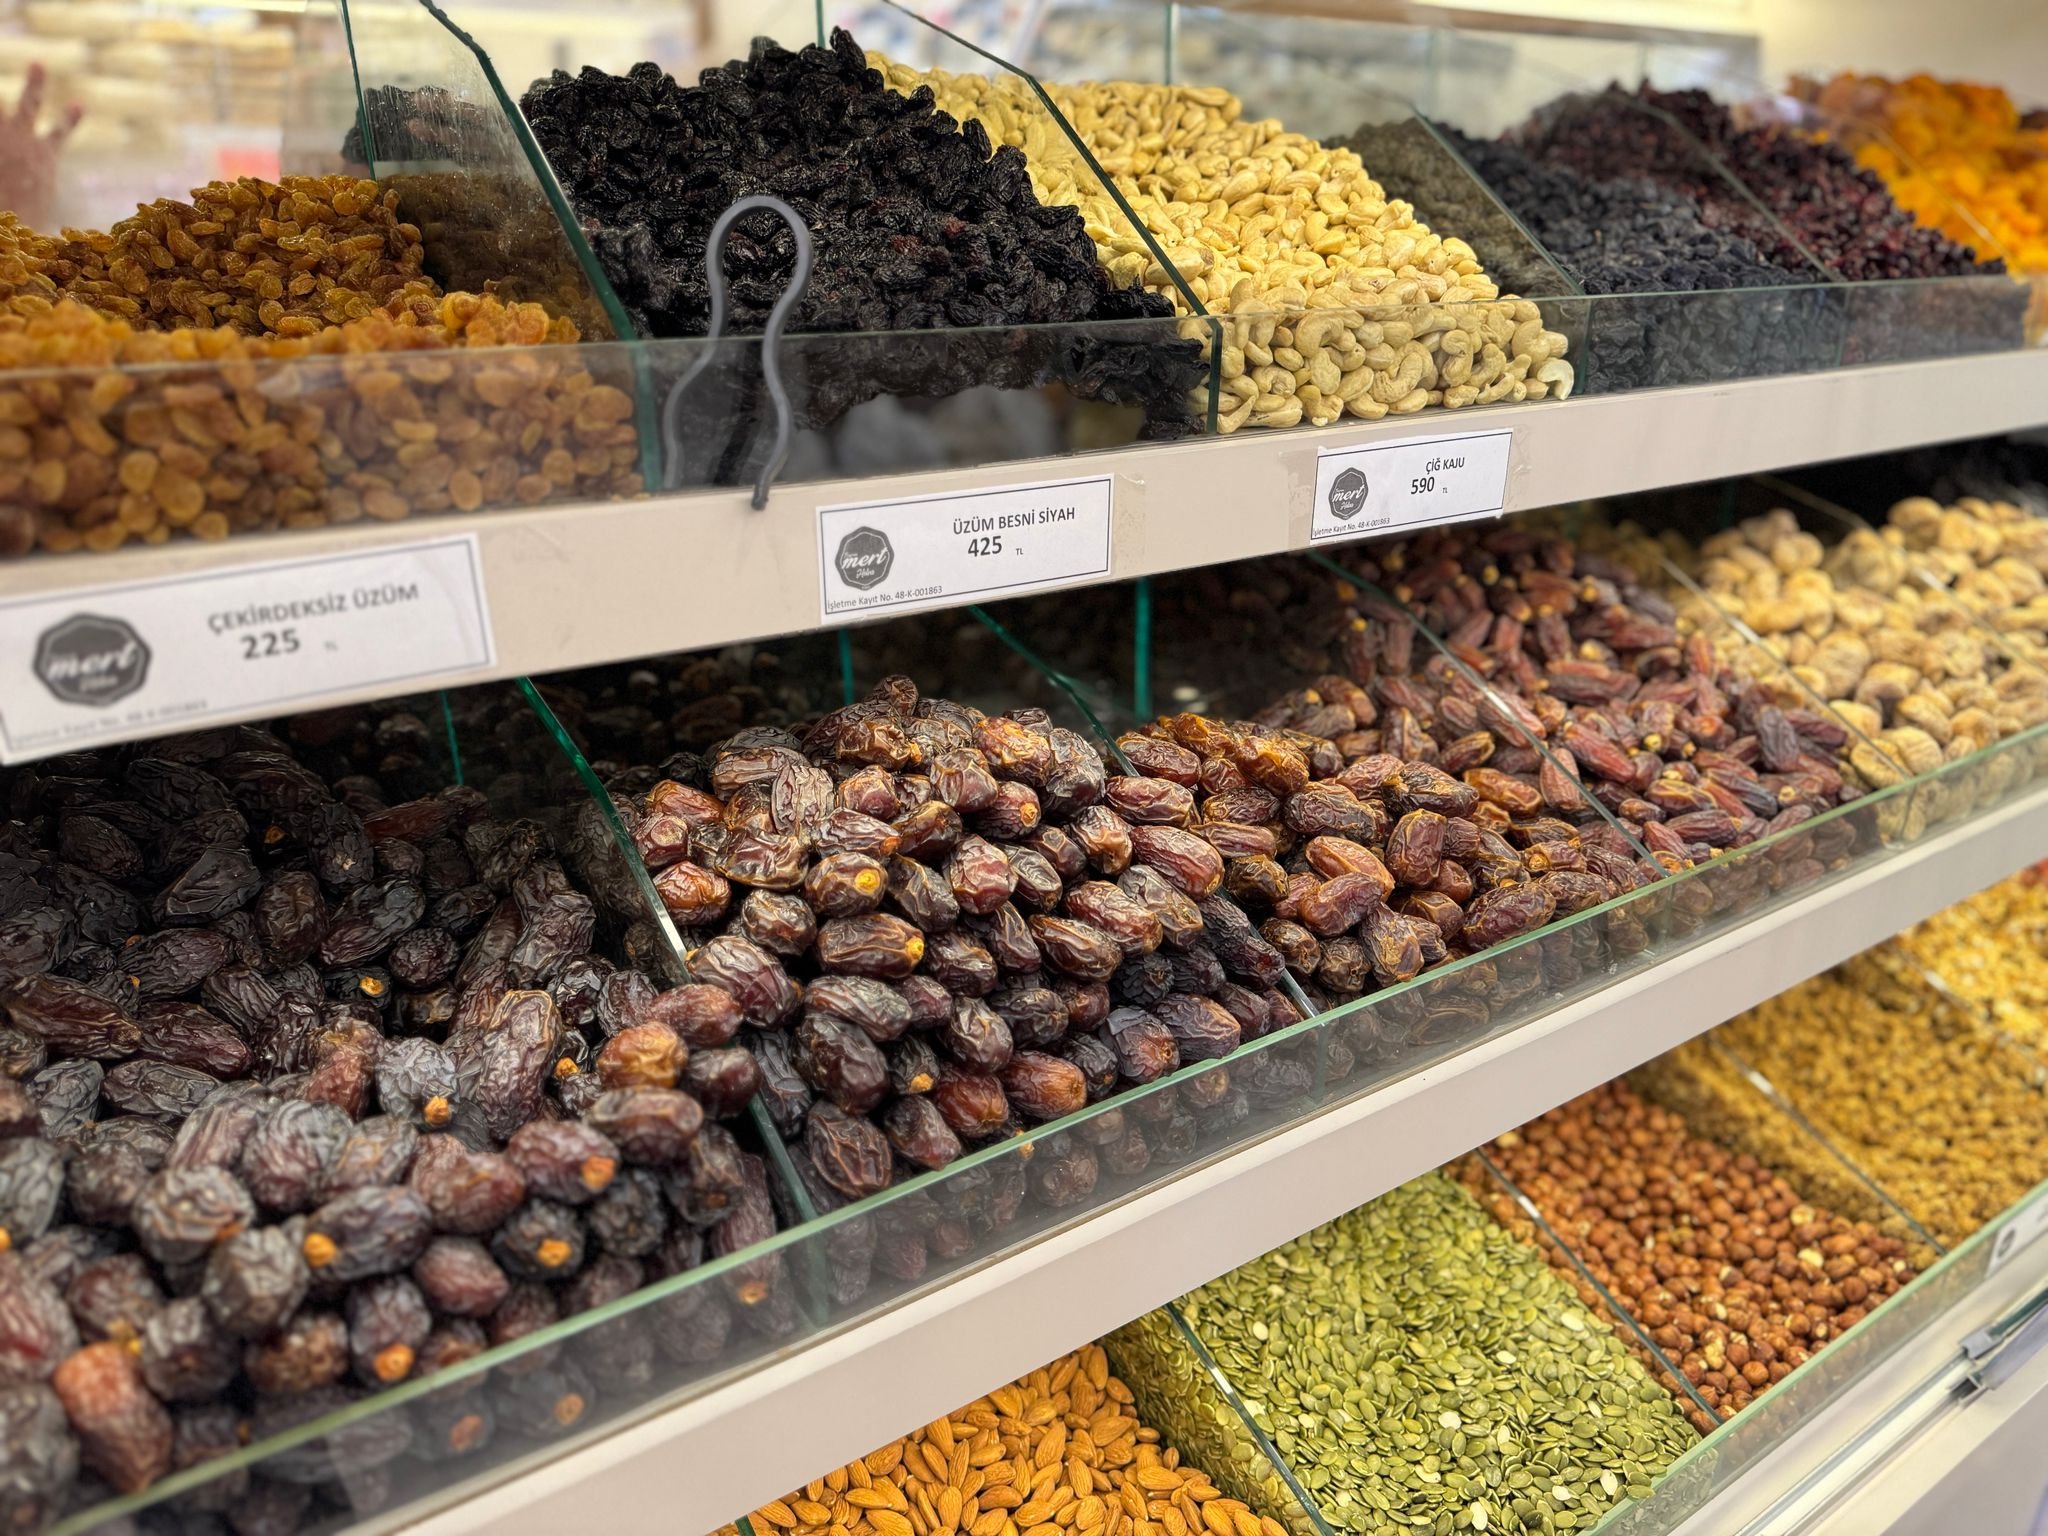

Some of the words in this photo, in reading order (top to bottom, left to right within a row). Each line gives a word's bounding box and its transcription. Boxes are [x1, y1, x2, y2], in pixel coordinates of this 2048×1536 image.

[1425, 457, 1441, 475] ÇİĞ
[1443, 456, 1465, 470] KAJU
[1331, 484, 1365, 502] mert
[1410, 476, 1435, 495] 590
[953, 516, 994, 535] ÜZÜM
[998, 509, 1035, 531] BESNİ
[1038, 506, 1076, 524] SİYAH
[841, 546, 889, 569] mert
[967, 535, 1003, 558] 425
[1015, 548, 1024, 556] TL
[858, 595, 878, 606] Kayıt
[880, 594, 894, 602] No.
[895, 585, 943, 600] 48-K-001863
[207, 592, 348, 637] ÇEKİRDEKSİZ
[352, 582, 421, 610] ÜZÜM
[239, 627, 302, 661] 225
[46, 639, 138, 682] mert
